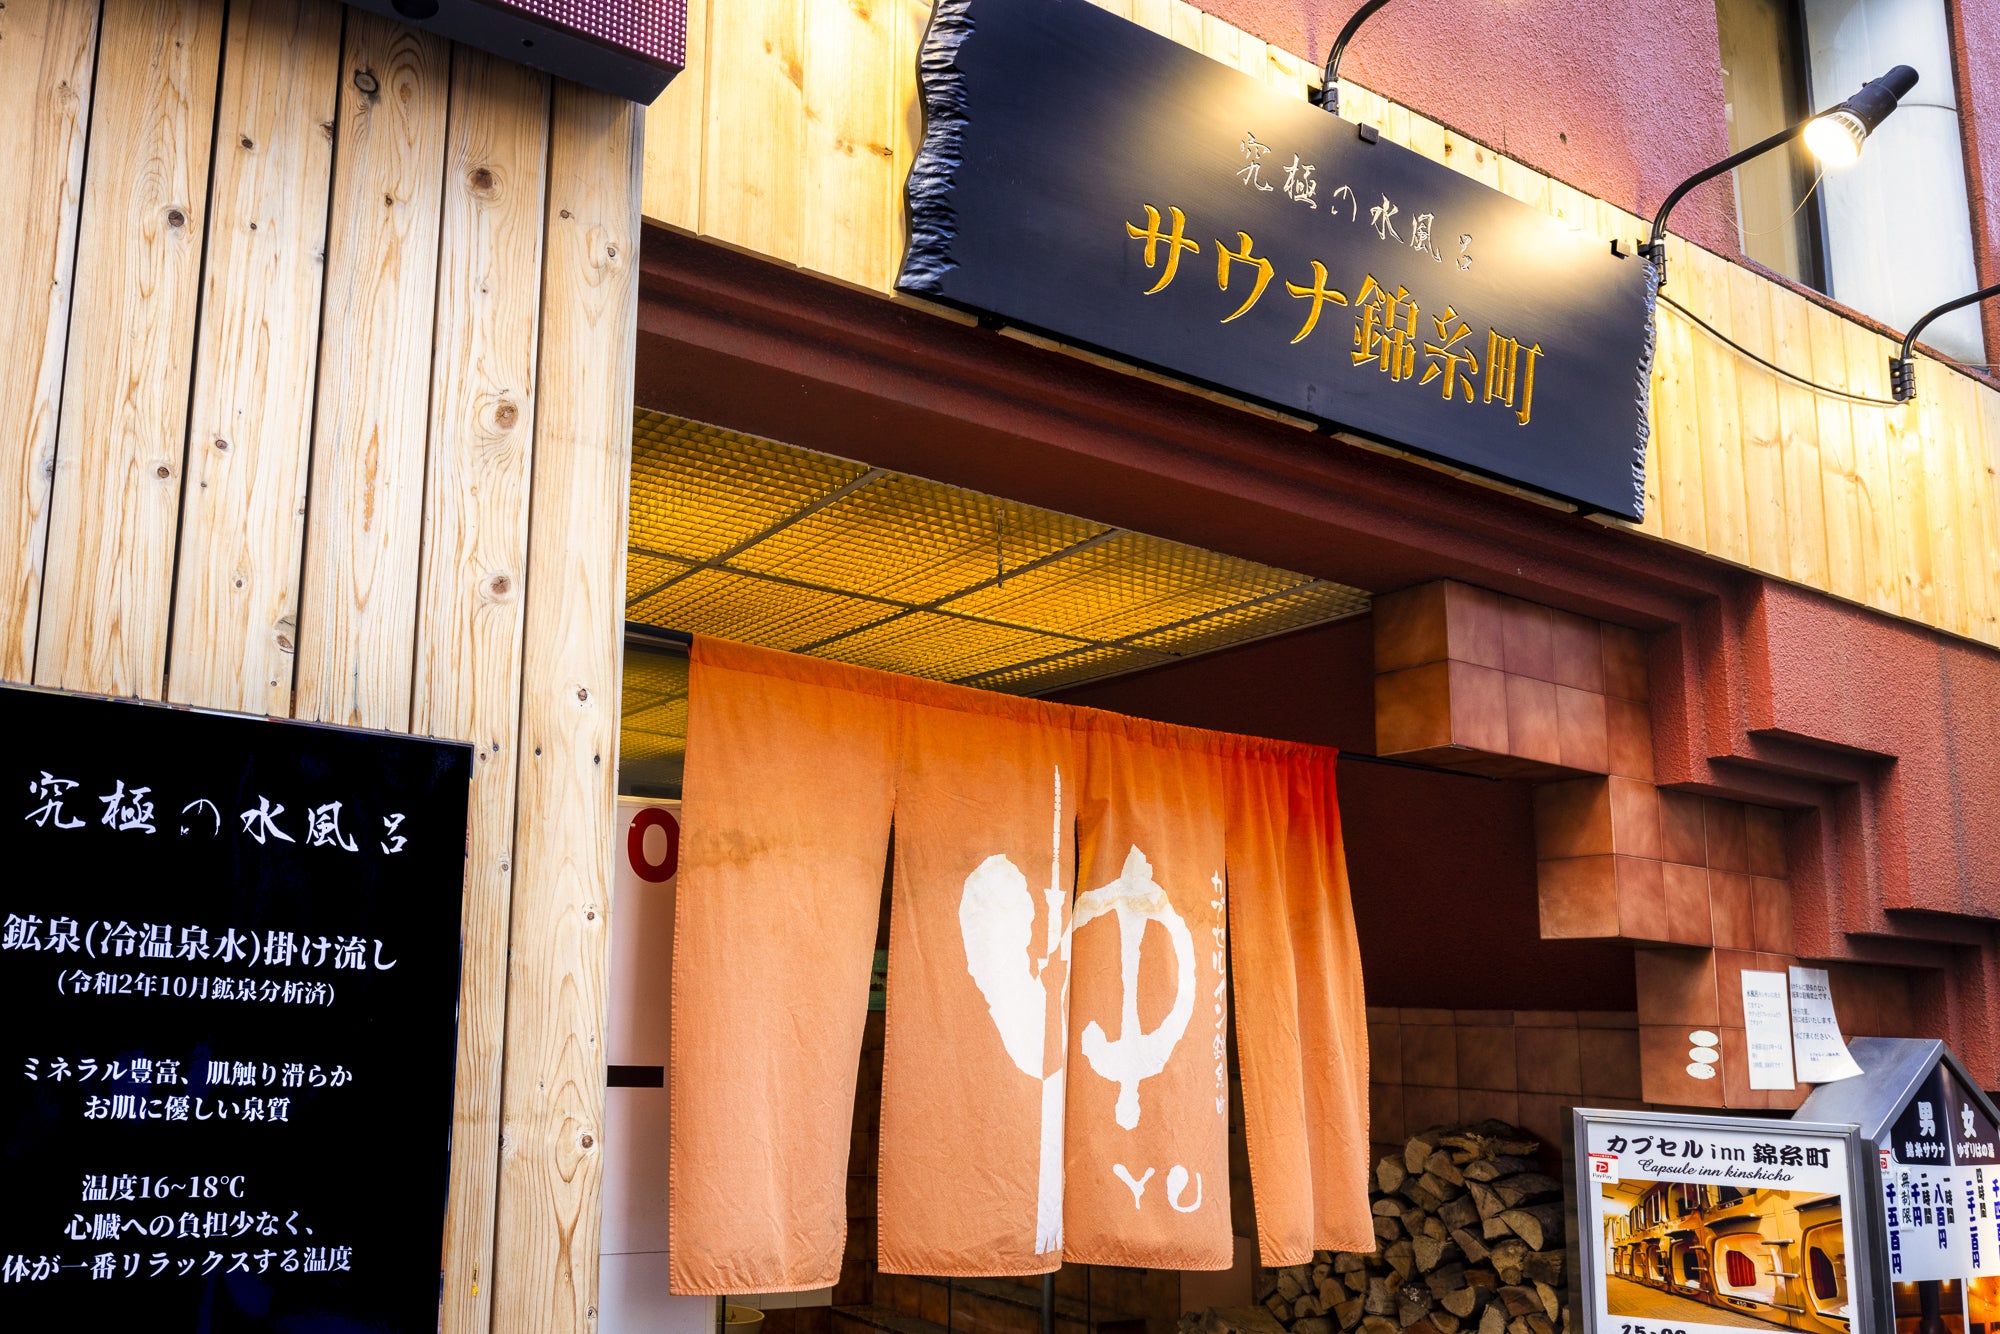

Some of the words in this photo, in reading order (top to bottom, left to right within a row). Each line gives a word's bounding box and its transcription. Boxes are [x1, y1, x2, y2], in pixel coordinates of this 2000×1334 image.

[1237, 131, 1473, 272] 究極の水風呂
[1126, 203, 1544, 426] サウナ錦糸町
[25, 771, 408, 855] 究極の水風呂
[24, 1057, 353, 1088] ミネラル豊富、肌触り滑らか
[83, 1094, 291, 1123] お肌に優しい泉質
[1918, 1101, 1935, 1137] 男
[1961, 1103, 1976, 1138] 女
[1607, 1135, 1704, 1160] カプセル
[1711, 1143, 1745, 1162] inn
[1753, 1143, 1831, 1169] 錦糸町
[1638, 1159, 1697, 1176] Capsule
[1699, 1165, 1723, 1176] inn
[1725, 1167, 1794, 1182] kinshicho
[1901, 1172, 1912, 1223] 無制限
[1911, 1183, 1922, 1227] 千円
[1935, 1183, 1947, 1249] 八百円
[64, 1210, 313, 1241] 心臓への負担少なく、
[1886, 1183, 1902, 1274] 千五百円
[2, 1246, 353, 1284] 体が一番リラックスする温度
